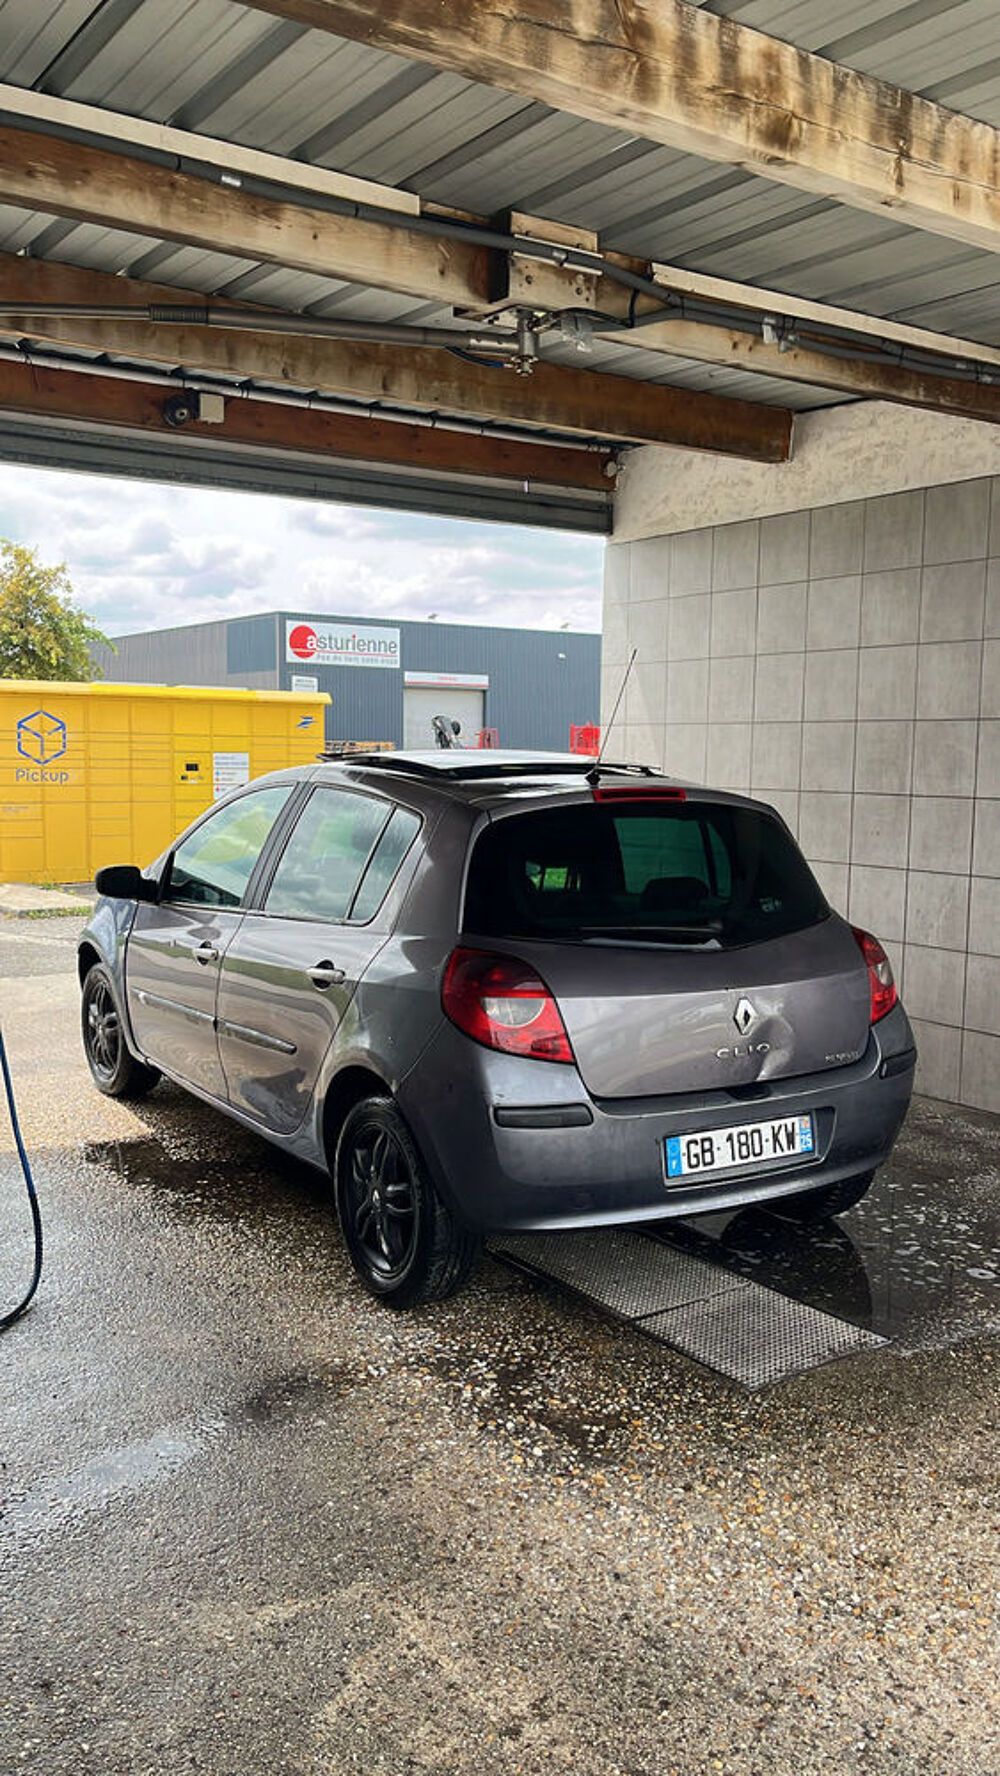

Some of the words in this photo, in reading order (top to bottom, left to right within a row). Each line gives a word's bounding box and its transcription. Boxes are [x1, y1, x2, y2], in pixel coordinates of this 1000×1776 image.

[306, 632, 397, 653] asturienne
[16, 768, 69, 784] Pickup
[716, 1043, 770, 1058] CLIO
